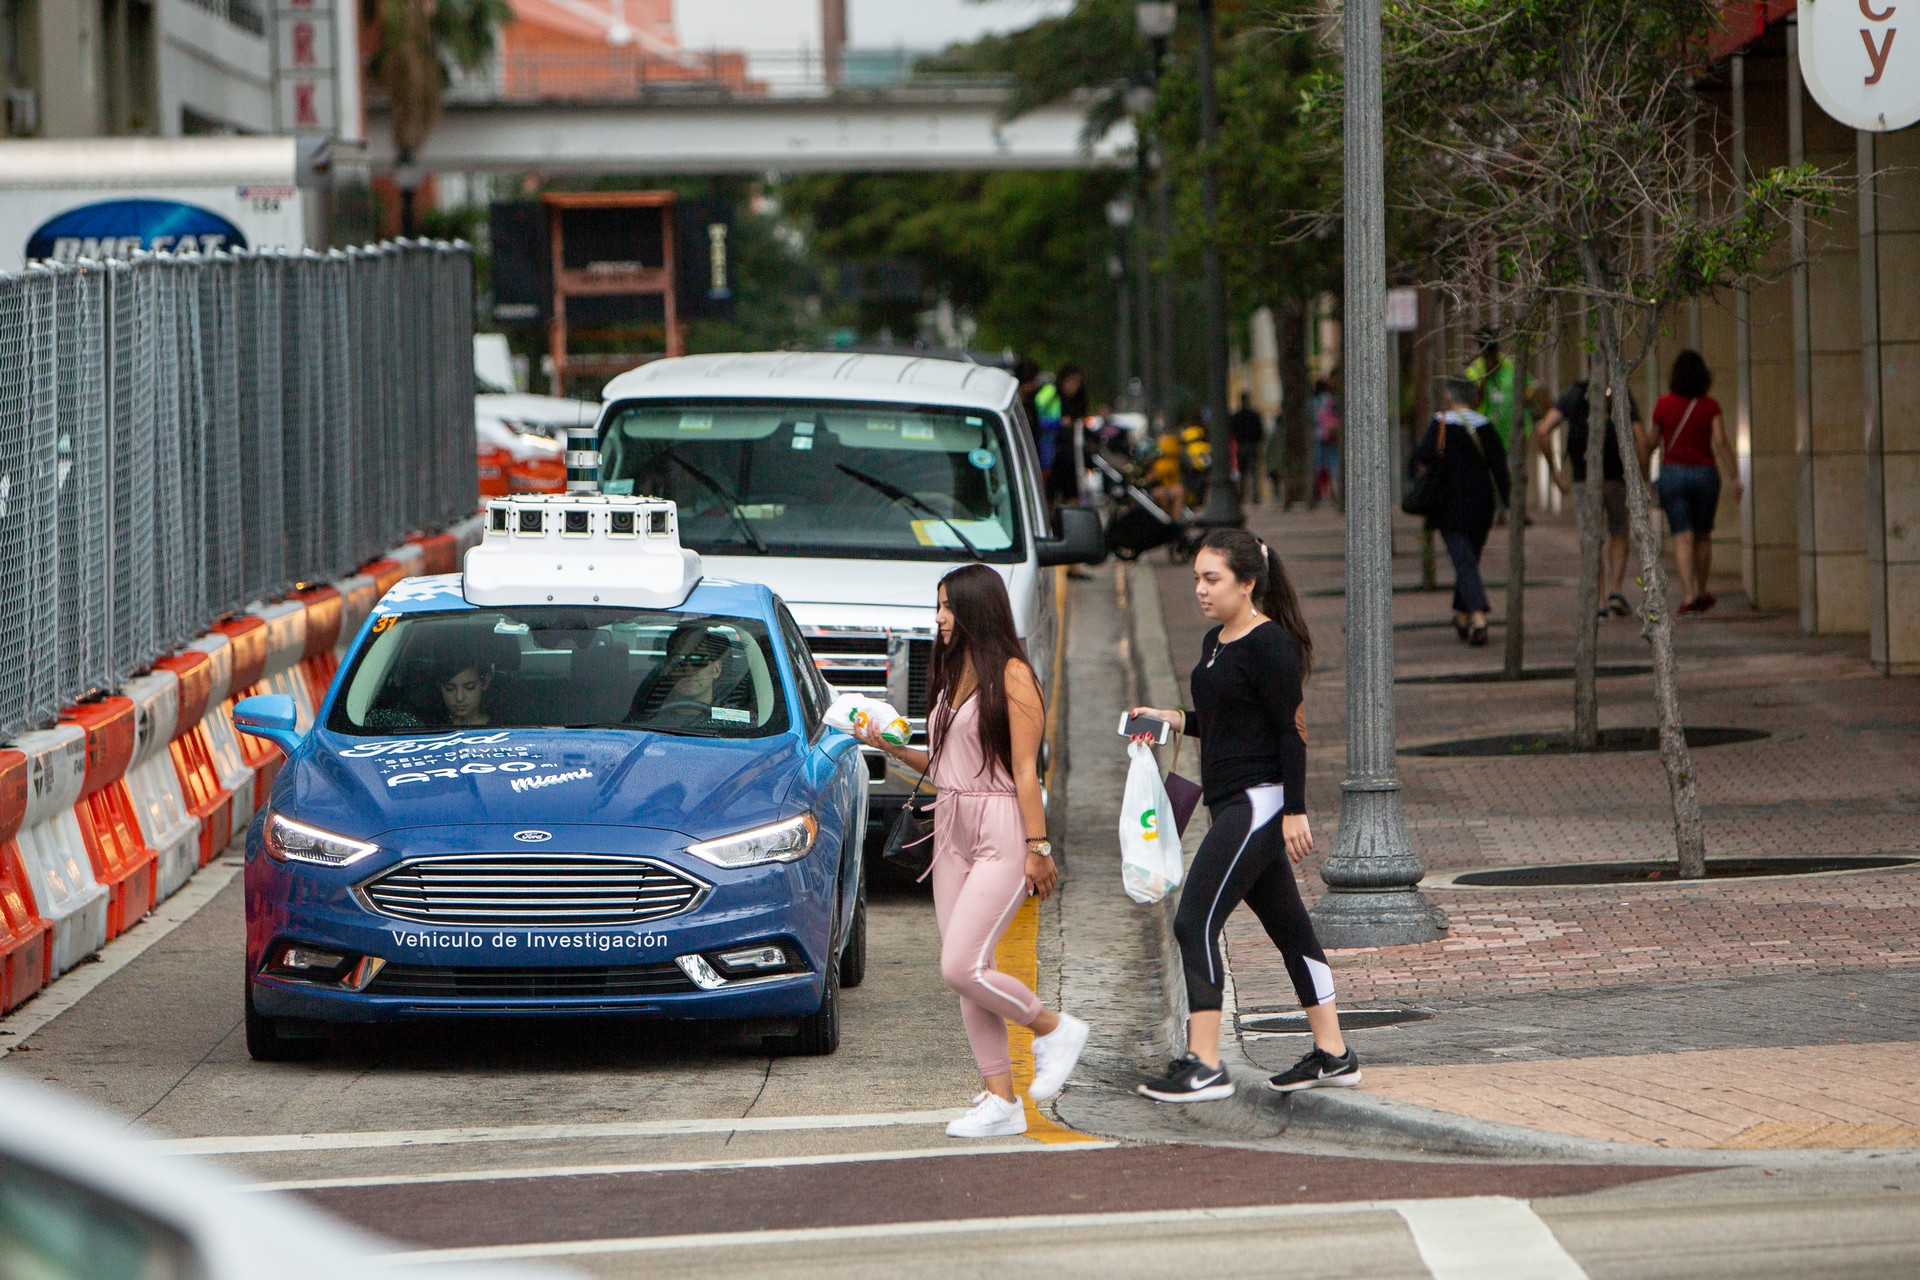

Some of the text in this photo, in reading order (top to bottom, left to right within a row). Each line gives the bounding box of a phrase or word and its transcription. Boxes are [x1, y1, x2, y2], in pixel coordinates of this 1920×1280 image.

[291, 0, 317, 125] RK
[372, 616, 398, 633] 31
[339, 732, 510, 758] Ford
[385, 746, 528, 765] SELF-DRIVING
[387, 751, 530, 770] TEST VEHICLE
[386, 761, 537, 787] ARGO
[510, 767, 594, 793] Miami
[492, 931, 517, 948] de
[527, 930, 668, 952] Investigación
